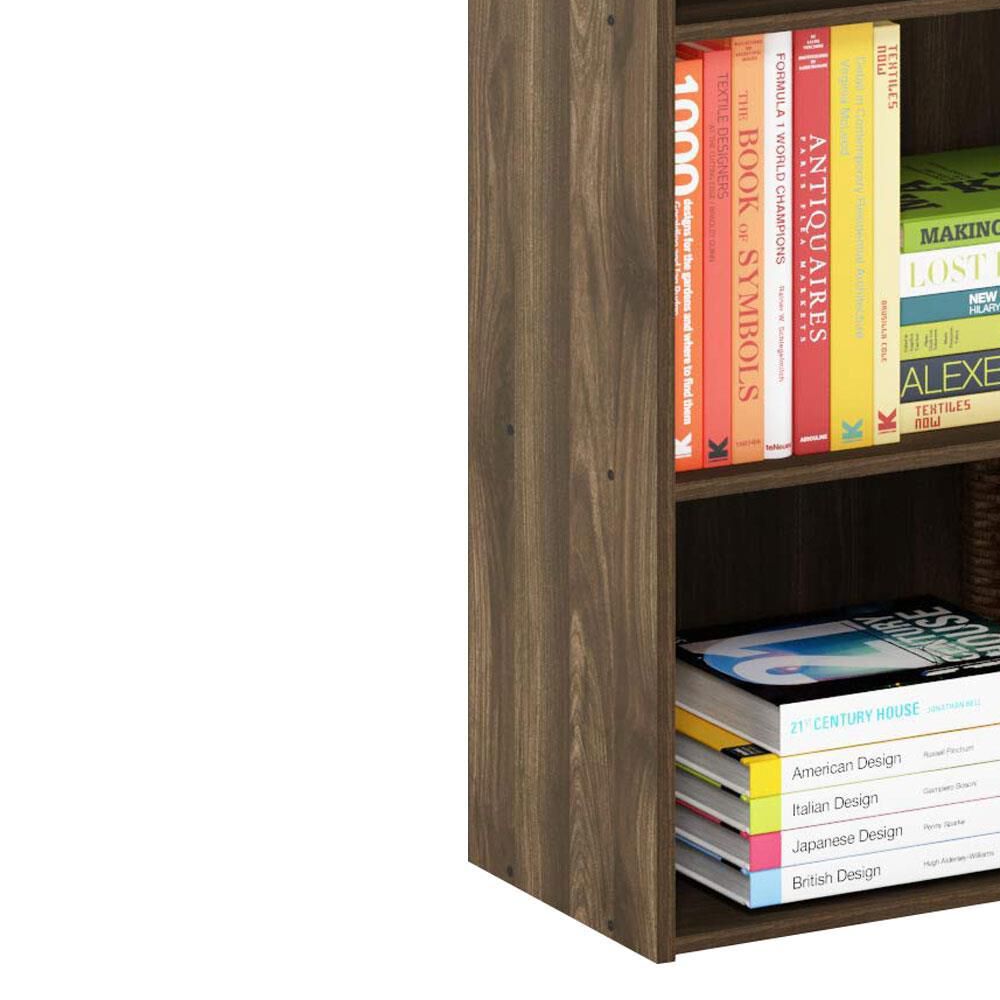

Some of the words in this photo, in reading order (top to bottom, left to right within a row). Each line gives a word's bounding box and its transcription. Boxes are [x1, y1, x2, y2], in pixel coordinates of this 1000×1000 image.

[776, 52, 786, 116] FORMULA
[887, 44, 898, 110] TEXTILES
[717, 73, 729, 123] TEXTILE
[738, 90, 749, 121] THE
[717, 127, 729, 200] DESIGNERS
[776, 133, 786, 181] WORLD
[799, 136, 807, 190] PARIS
[738, 128, 759, 217] BOOK
[681, 198, 693, 236] designs
[776, 185, 786, 265] CHAMPIONS
[799, 204, 807, 245] FLEA
[684, 238, 694, 253] for
[738, 223, 749, 243] OF
[805, 134, 827, 343] ANTIQUAIRES
[684, 253, 694, 271] the
[909, 253, 987, 288] LOST
[799, 261, 807, 343] MARKETS
[969, 292, 998, 305] NEW
[969, 302, 1000, 316] HILARY
[684, 313, 693, 331] and
[738, 250, 759, 402] SYMBOLS
[684, 365, 693, 377] to
[684, 378, 694, 398] find
[684, 398, 693, 425] them
[916, 399, 971, 417] TEXTILES
[814, 710, 873, 730] CENTURY
[876, 702, 920, 721] HOUSE
[792, 761, 854, 780] American
[857, 753, 902, 771] Design
[792, 800, 830, 816] Italian
[834, 793, 879, 810] Design
[792, 832, 855, 854] Japanese
[859, 826, 903, 843] Design
[792, 871, 833, 890] British
[837, 866, 881, 883] Design
